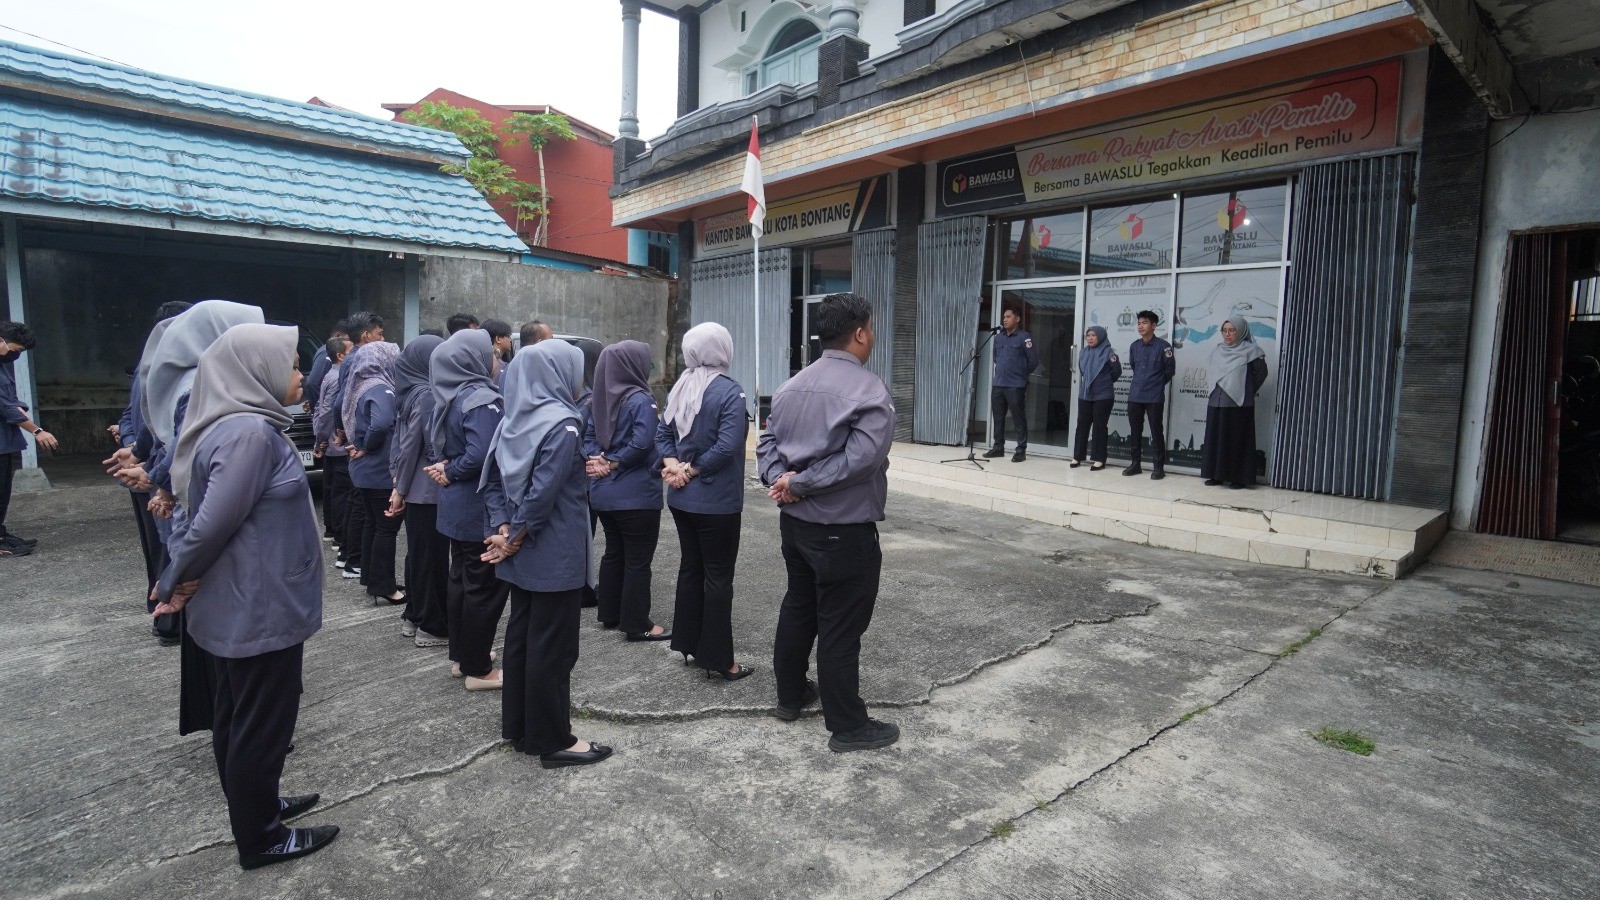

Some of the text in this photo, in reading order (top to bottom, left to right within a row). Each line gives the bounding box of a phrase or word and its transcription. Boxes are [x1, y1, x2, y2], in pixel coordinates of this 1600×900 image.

[1027, 92, 1356, 177] Bersama Rakyat Awasi Pemilu
[1034, 175, 1080, 194] Bersama
[1084, 164, 1143, 185] BAWASLU
[1148, 154, 1211, 176] Tegakkan
[1221, 141, 1289, 163] Keadilan
[1295, 128, 1353, 151] Pemilu
[968, 168, 1015, 186] BAWASLU
[705, 227, 734, 247] KANTOR
[735, 217, 773, 241] BAWLU
[775, 213, 798, 232] KOTA
[801, 202, 851, 228] BONTANG
[1204, 231, 1258, 245] BAWASLU
[1107, 241, 1153, 253] BAWASLU
